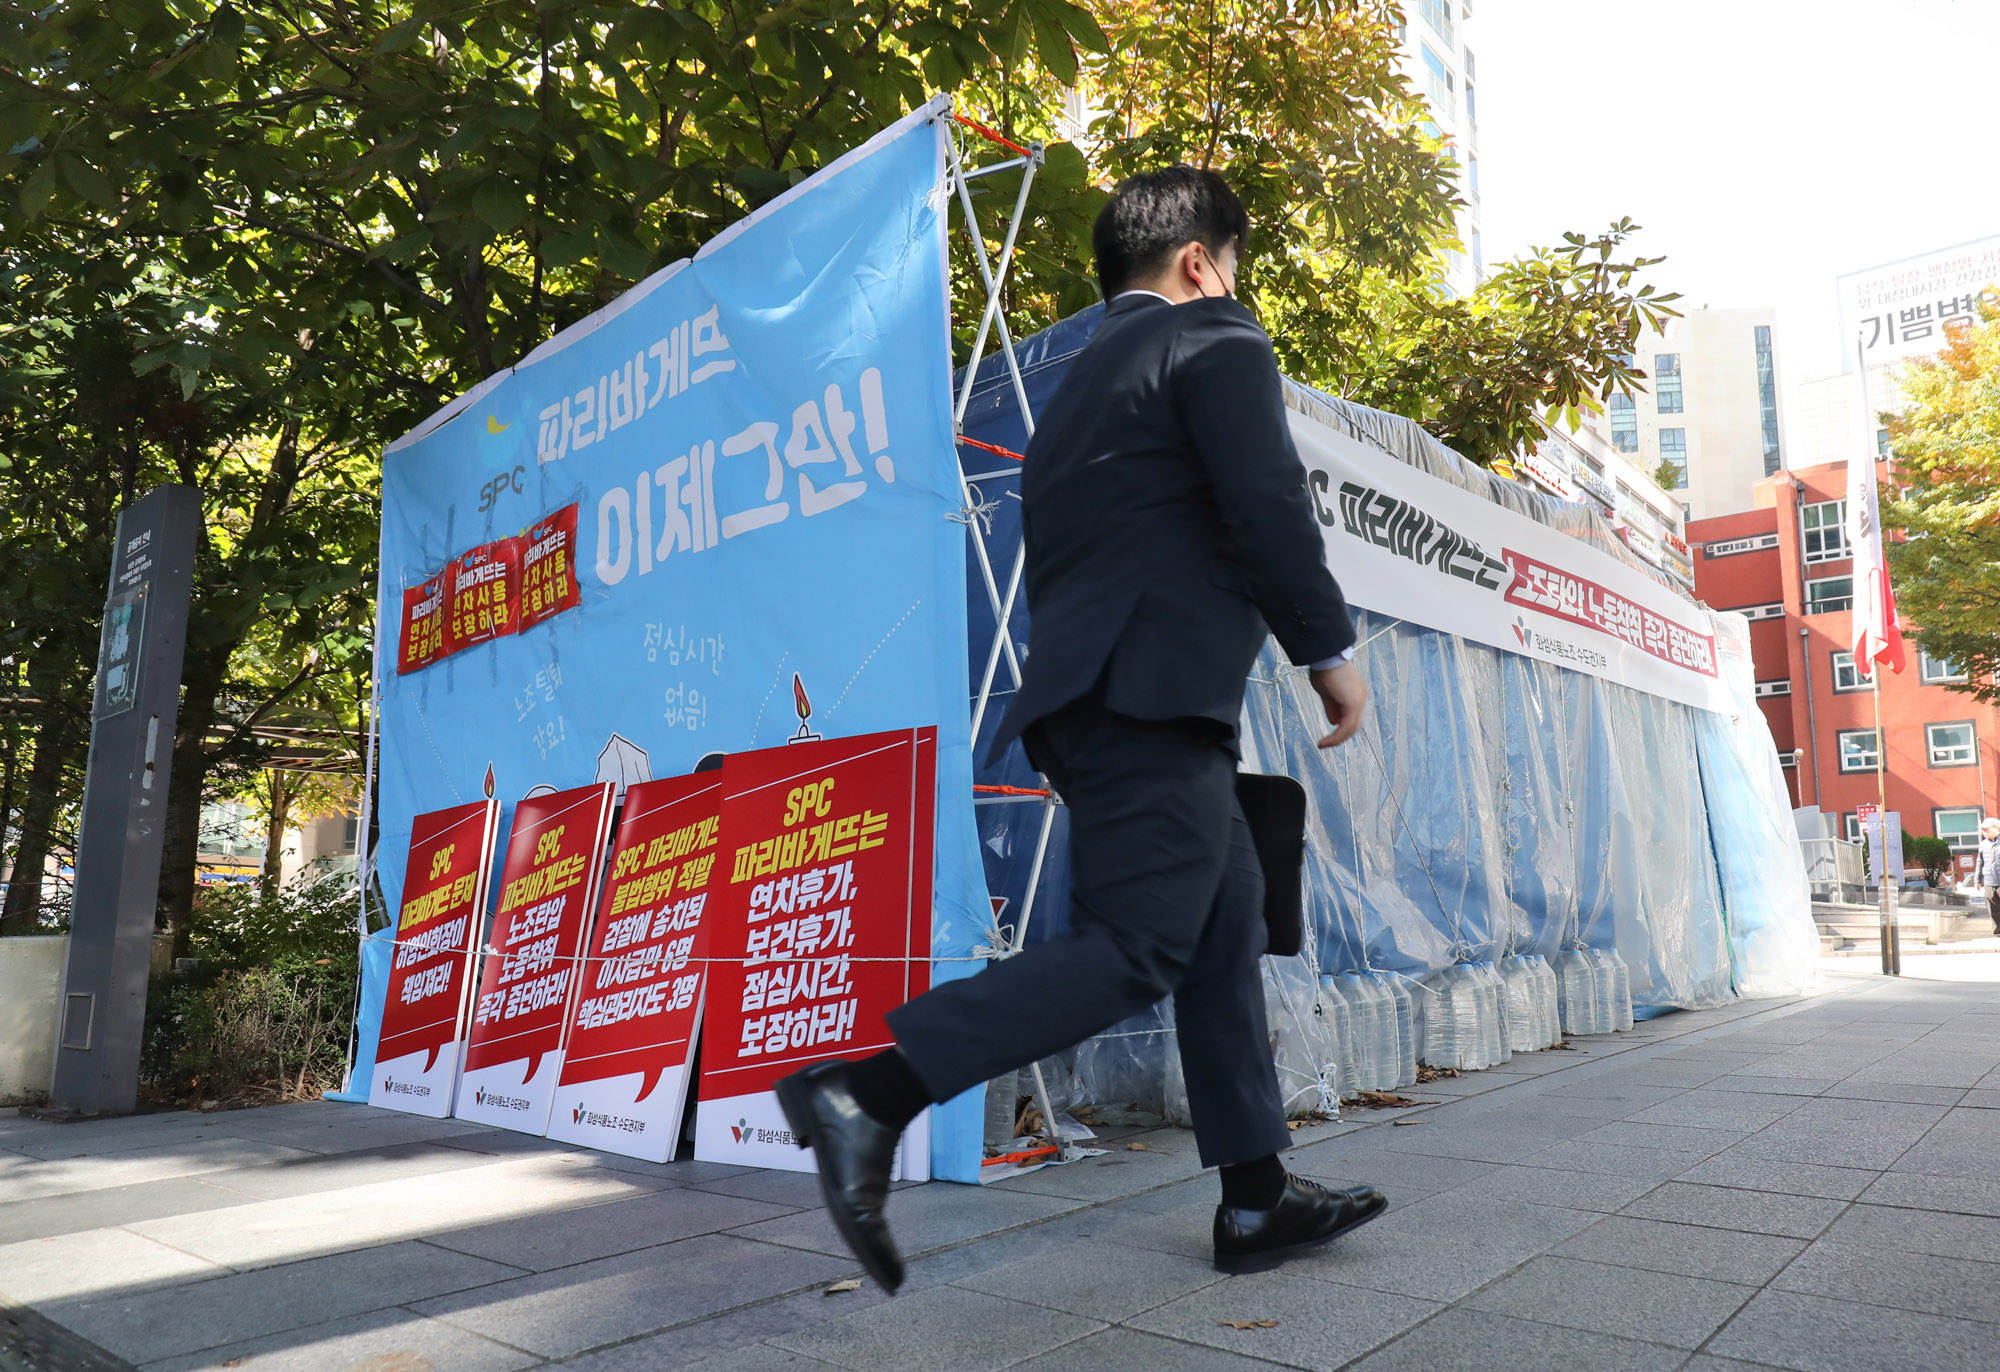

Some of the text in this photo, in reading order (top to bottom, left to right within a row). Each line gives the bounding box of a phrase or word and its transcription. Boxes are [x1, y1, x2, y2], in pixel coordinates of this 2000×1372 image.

[1860, 290, 2000, 349] 기쁨병
[538, 303, 736, 465] 파리바게뜨
[478, 465, 525, 513] SPC
[523, 530, 566, 570] 파리바게뜨는
[543, 524, 553, 537] SPC
[455, 561, 507, 595] 파리바게뜨는
[474, 554, 487, 565] SPC
[643, 622, 725, 676] 점심시간
[1535, 633, 1608, 671] 화섬식품노조 수도권지부
[1588, 587, 1645, 650] 노동착취
[1643, 611, 1670, 660] 즉각
[1668, 622, 1715, 675] 중단하라!
[664, 681, 707, 731] 없음!
[533, 715, 566, 761] 강요!
[783, 777, 835, 827] SPC
[429, 843, 455, 882] SPC
[533, 824, 566, 866] SPC
[612, 843, 645, 881] SPC
[730, 809, 889, 884] 파리바게뜨는
[398, 870, 479, 932] 파리바게뜨 문제
[500, 852, 587, 914] 파리바게뜨는
[609, 852, 717, 917] 불법행위 적발
[746, 860, 859, 924] 연차휴가,
[504, 894, 567, 948] 노조탄압
[601, 892, 708, 954] 검찰에 송치된
[742, 906, 856, 968] 보건휴가,
[400, 959, 454, 1005] 책임져라!
[497, 933, 560, 985] 노동착취
[596, 934, 697, 990] 이사급만 6명
[741, 953, 855, 1013] 점심시간,
[475, 967, 571, 1026] 즉각 중단하라!
[576, 972, 701, 1031] 핵심관리자도 3명
[737, 997, 859, 1059] 보장하라!
[393, 1081, 431, 1097] 화섬식품노조 수도권지부
[486, 1093, 531, 1112] 화섬식품노조 수도권지부
[586, 1111, 646, 1134] 화섬식품노조 수도권지부
